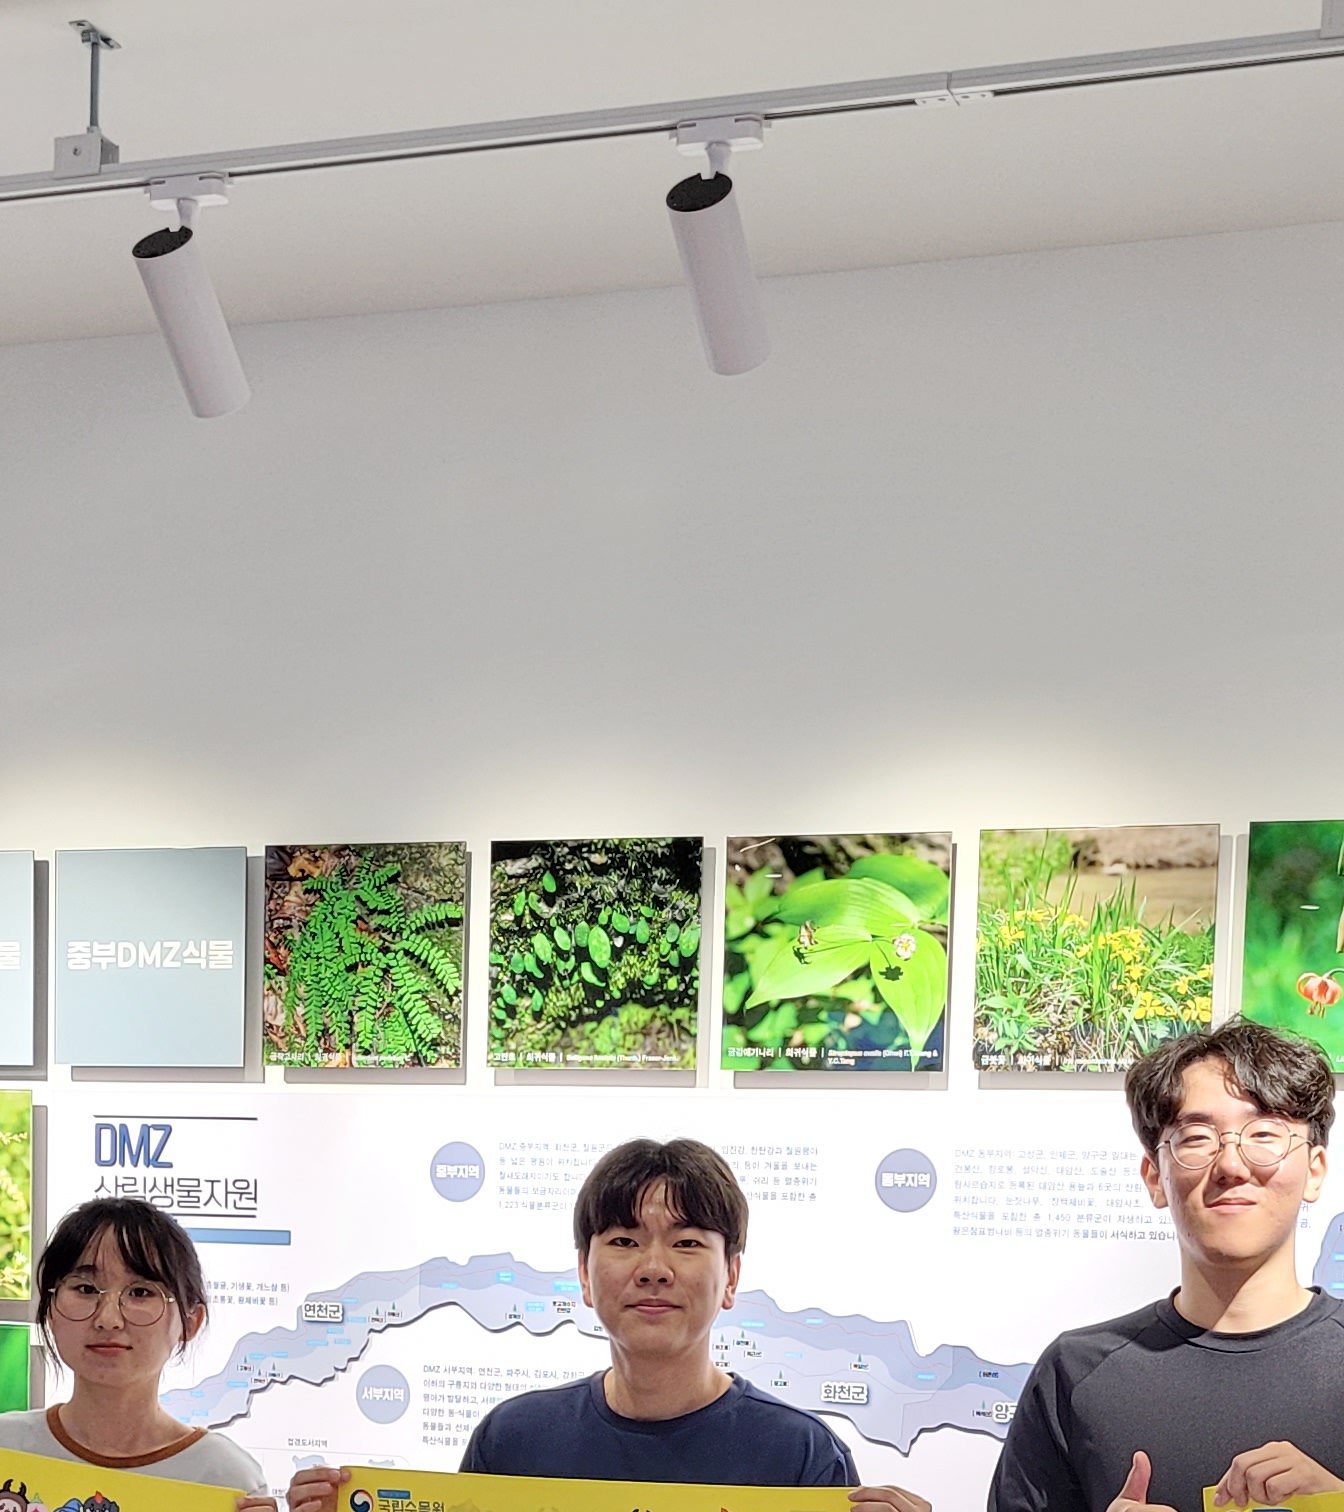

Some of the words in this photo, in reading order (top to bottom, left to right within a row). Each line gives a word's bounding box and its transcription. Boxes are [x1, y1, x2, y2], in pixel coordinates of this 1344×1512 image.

[67, 940, 234, 970] 중부DMZ식물
[95, 1123, 172, 1168] DMZ
[435, 1164, 480, 1180] 중부지역
[881, 1172, 931, 1189] 동부지역
[1111, 1231, 1145, 1240] 서식하고
[304, 1304, 341, 1319] 연천군
[362, 1386, 404, 1402] 서부지역
[823, 1383, 868, 1400] 화천군
